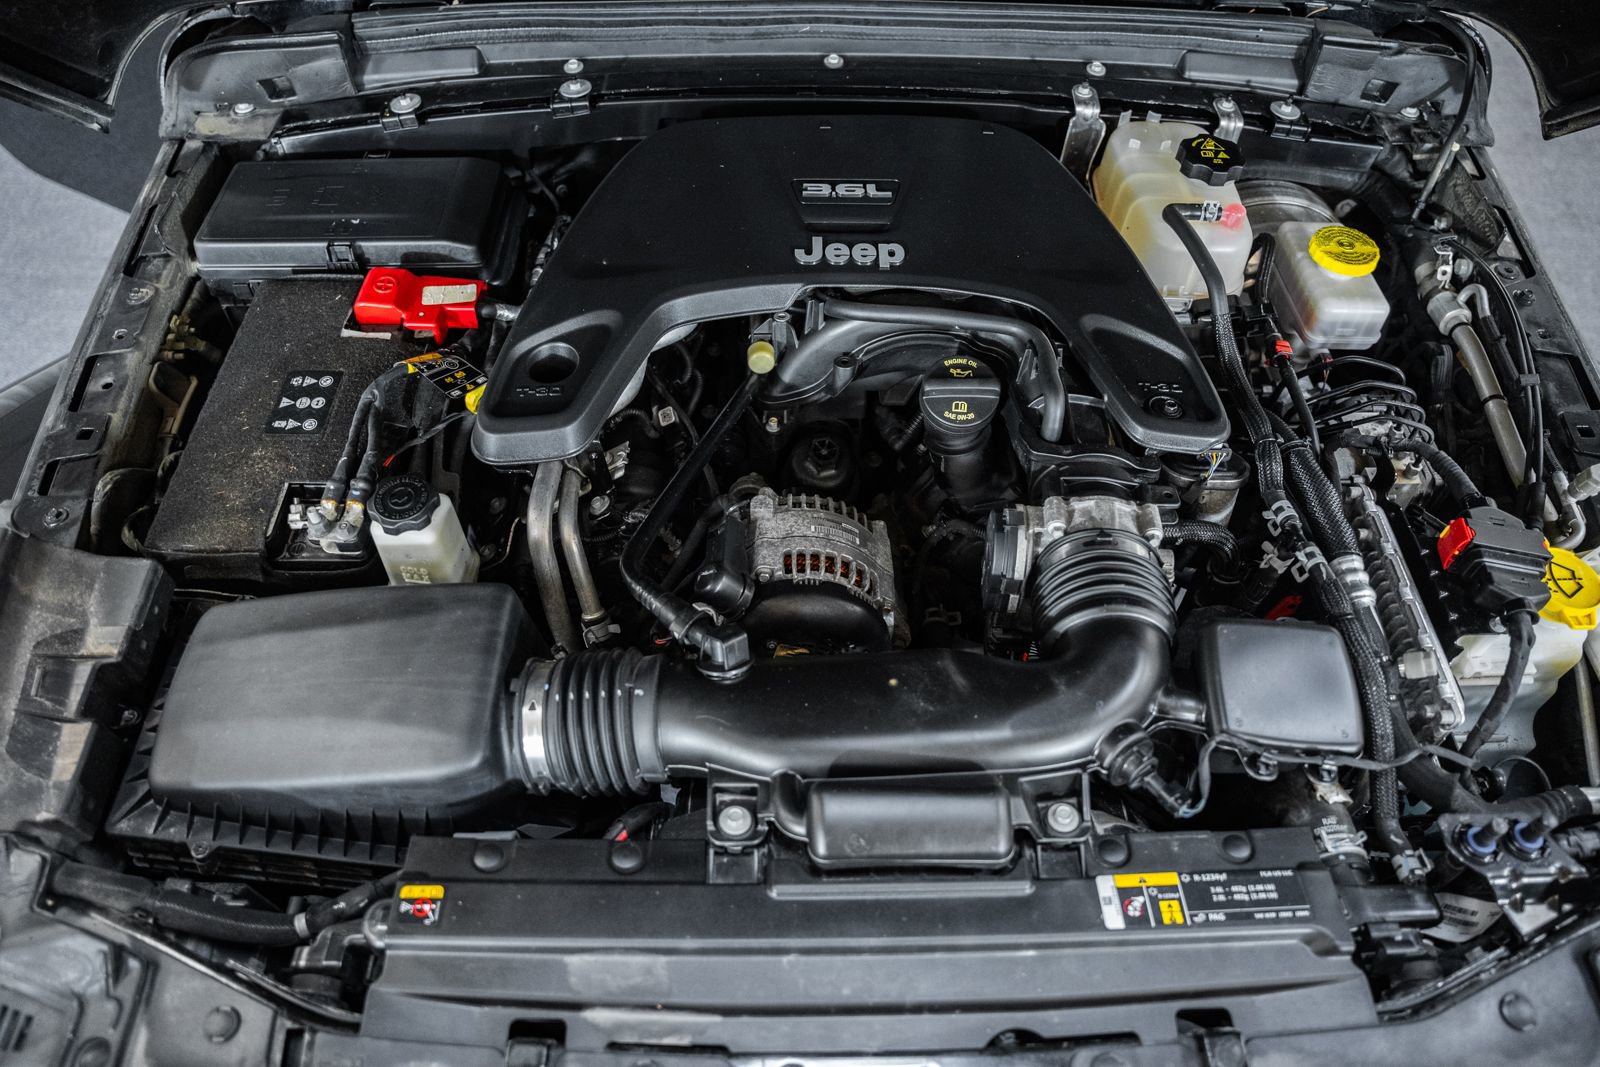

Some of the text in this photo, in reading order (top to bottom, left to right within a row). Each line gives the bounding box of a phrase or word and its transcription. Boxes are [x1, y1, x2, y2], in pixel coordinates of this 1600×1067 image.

[801, 183, 893, 198] 3.6L
[794, 236, 905, 270] Jeep
[944, 358, 978, 368] ENGINE OIL
[943, 411, 957, 420] SAE
[1208, 913, 1226, 921] PAG
